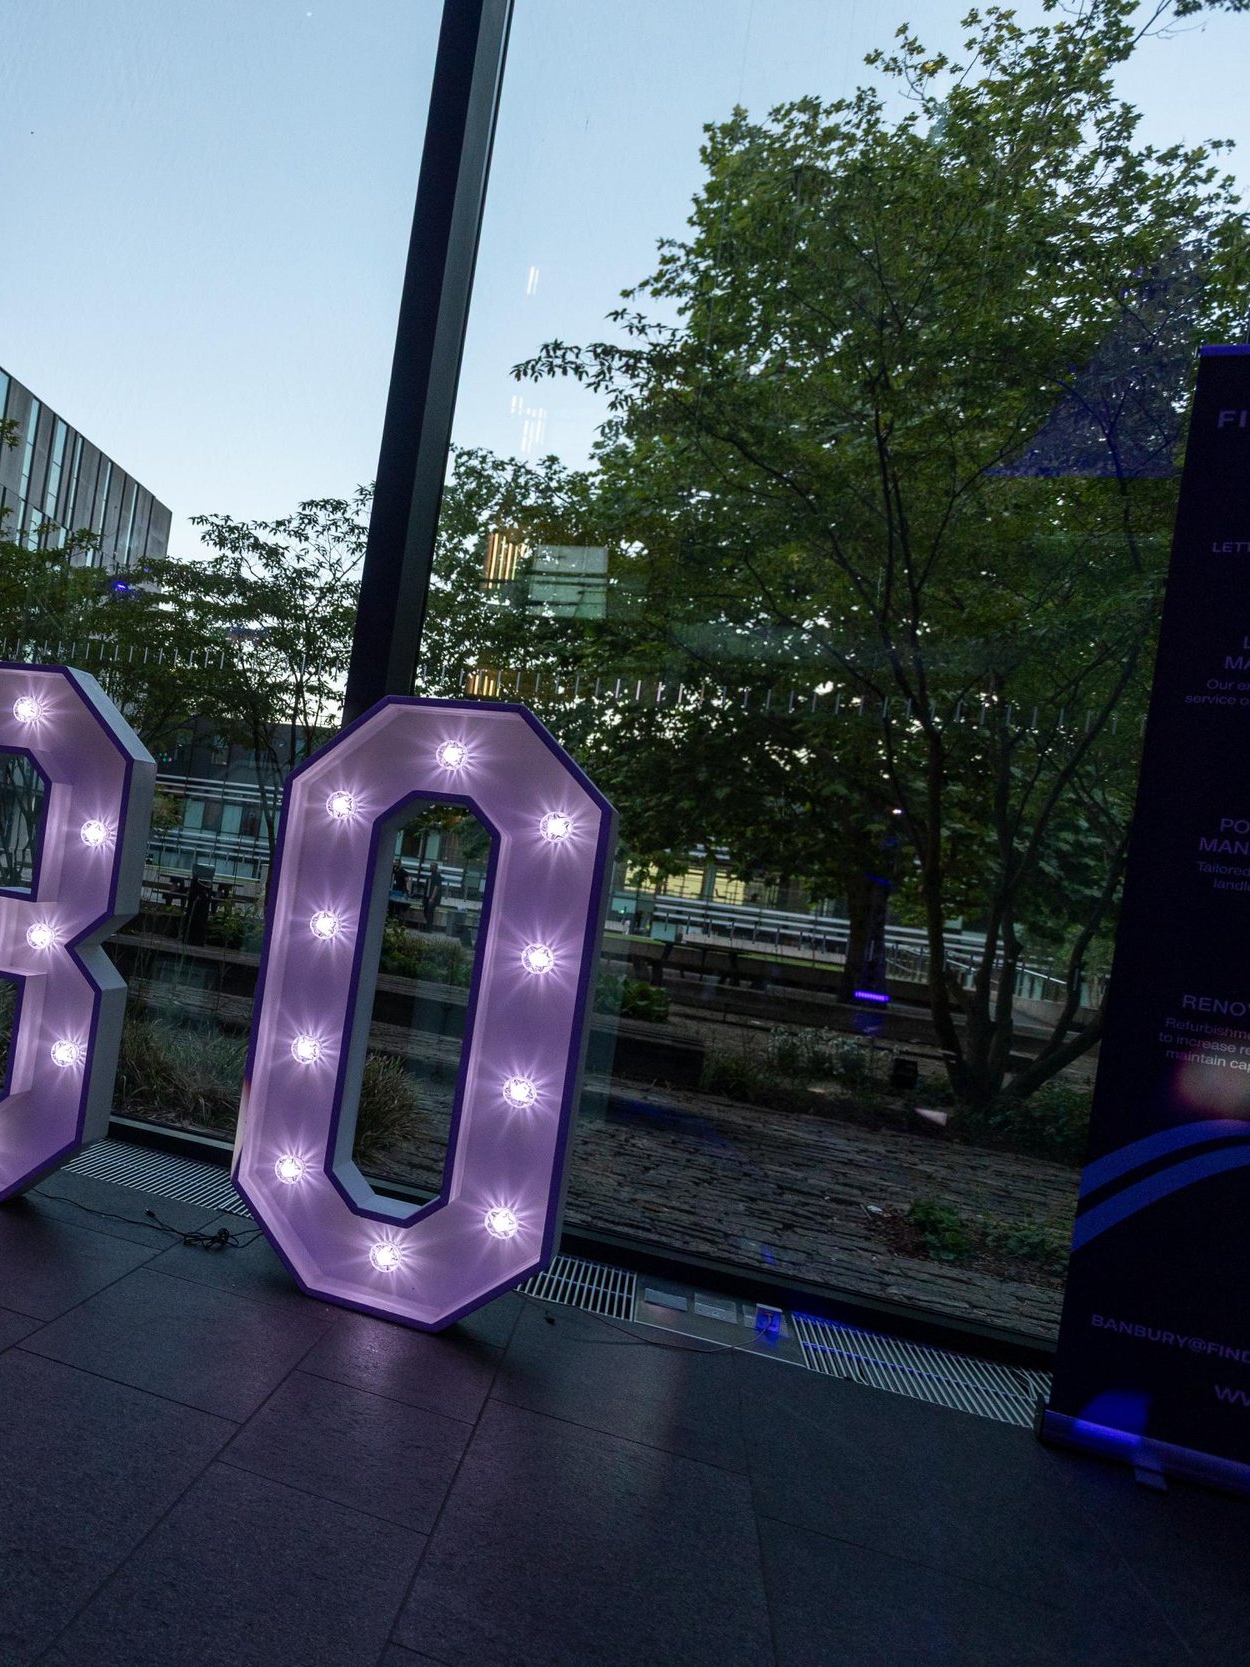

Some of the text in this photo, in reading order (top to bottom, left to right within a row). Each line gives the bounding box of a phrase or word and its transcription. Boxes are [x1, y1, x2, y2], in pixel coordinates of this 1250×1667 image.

[1206, 678, 1234, 690] Our
[1184, 694, 1237, 705] service
[1182, 994, 1250, 1017] RENO
[1158, 1032, 1173, 1043] to
[1176, 1035, 1237, 1053] increase
[1165, 1050, 1226, 1067] maintain
